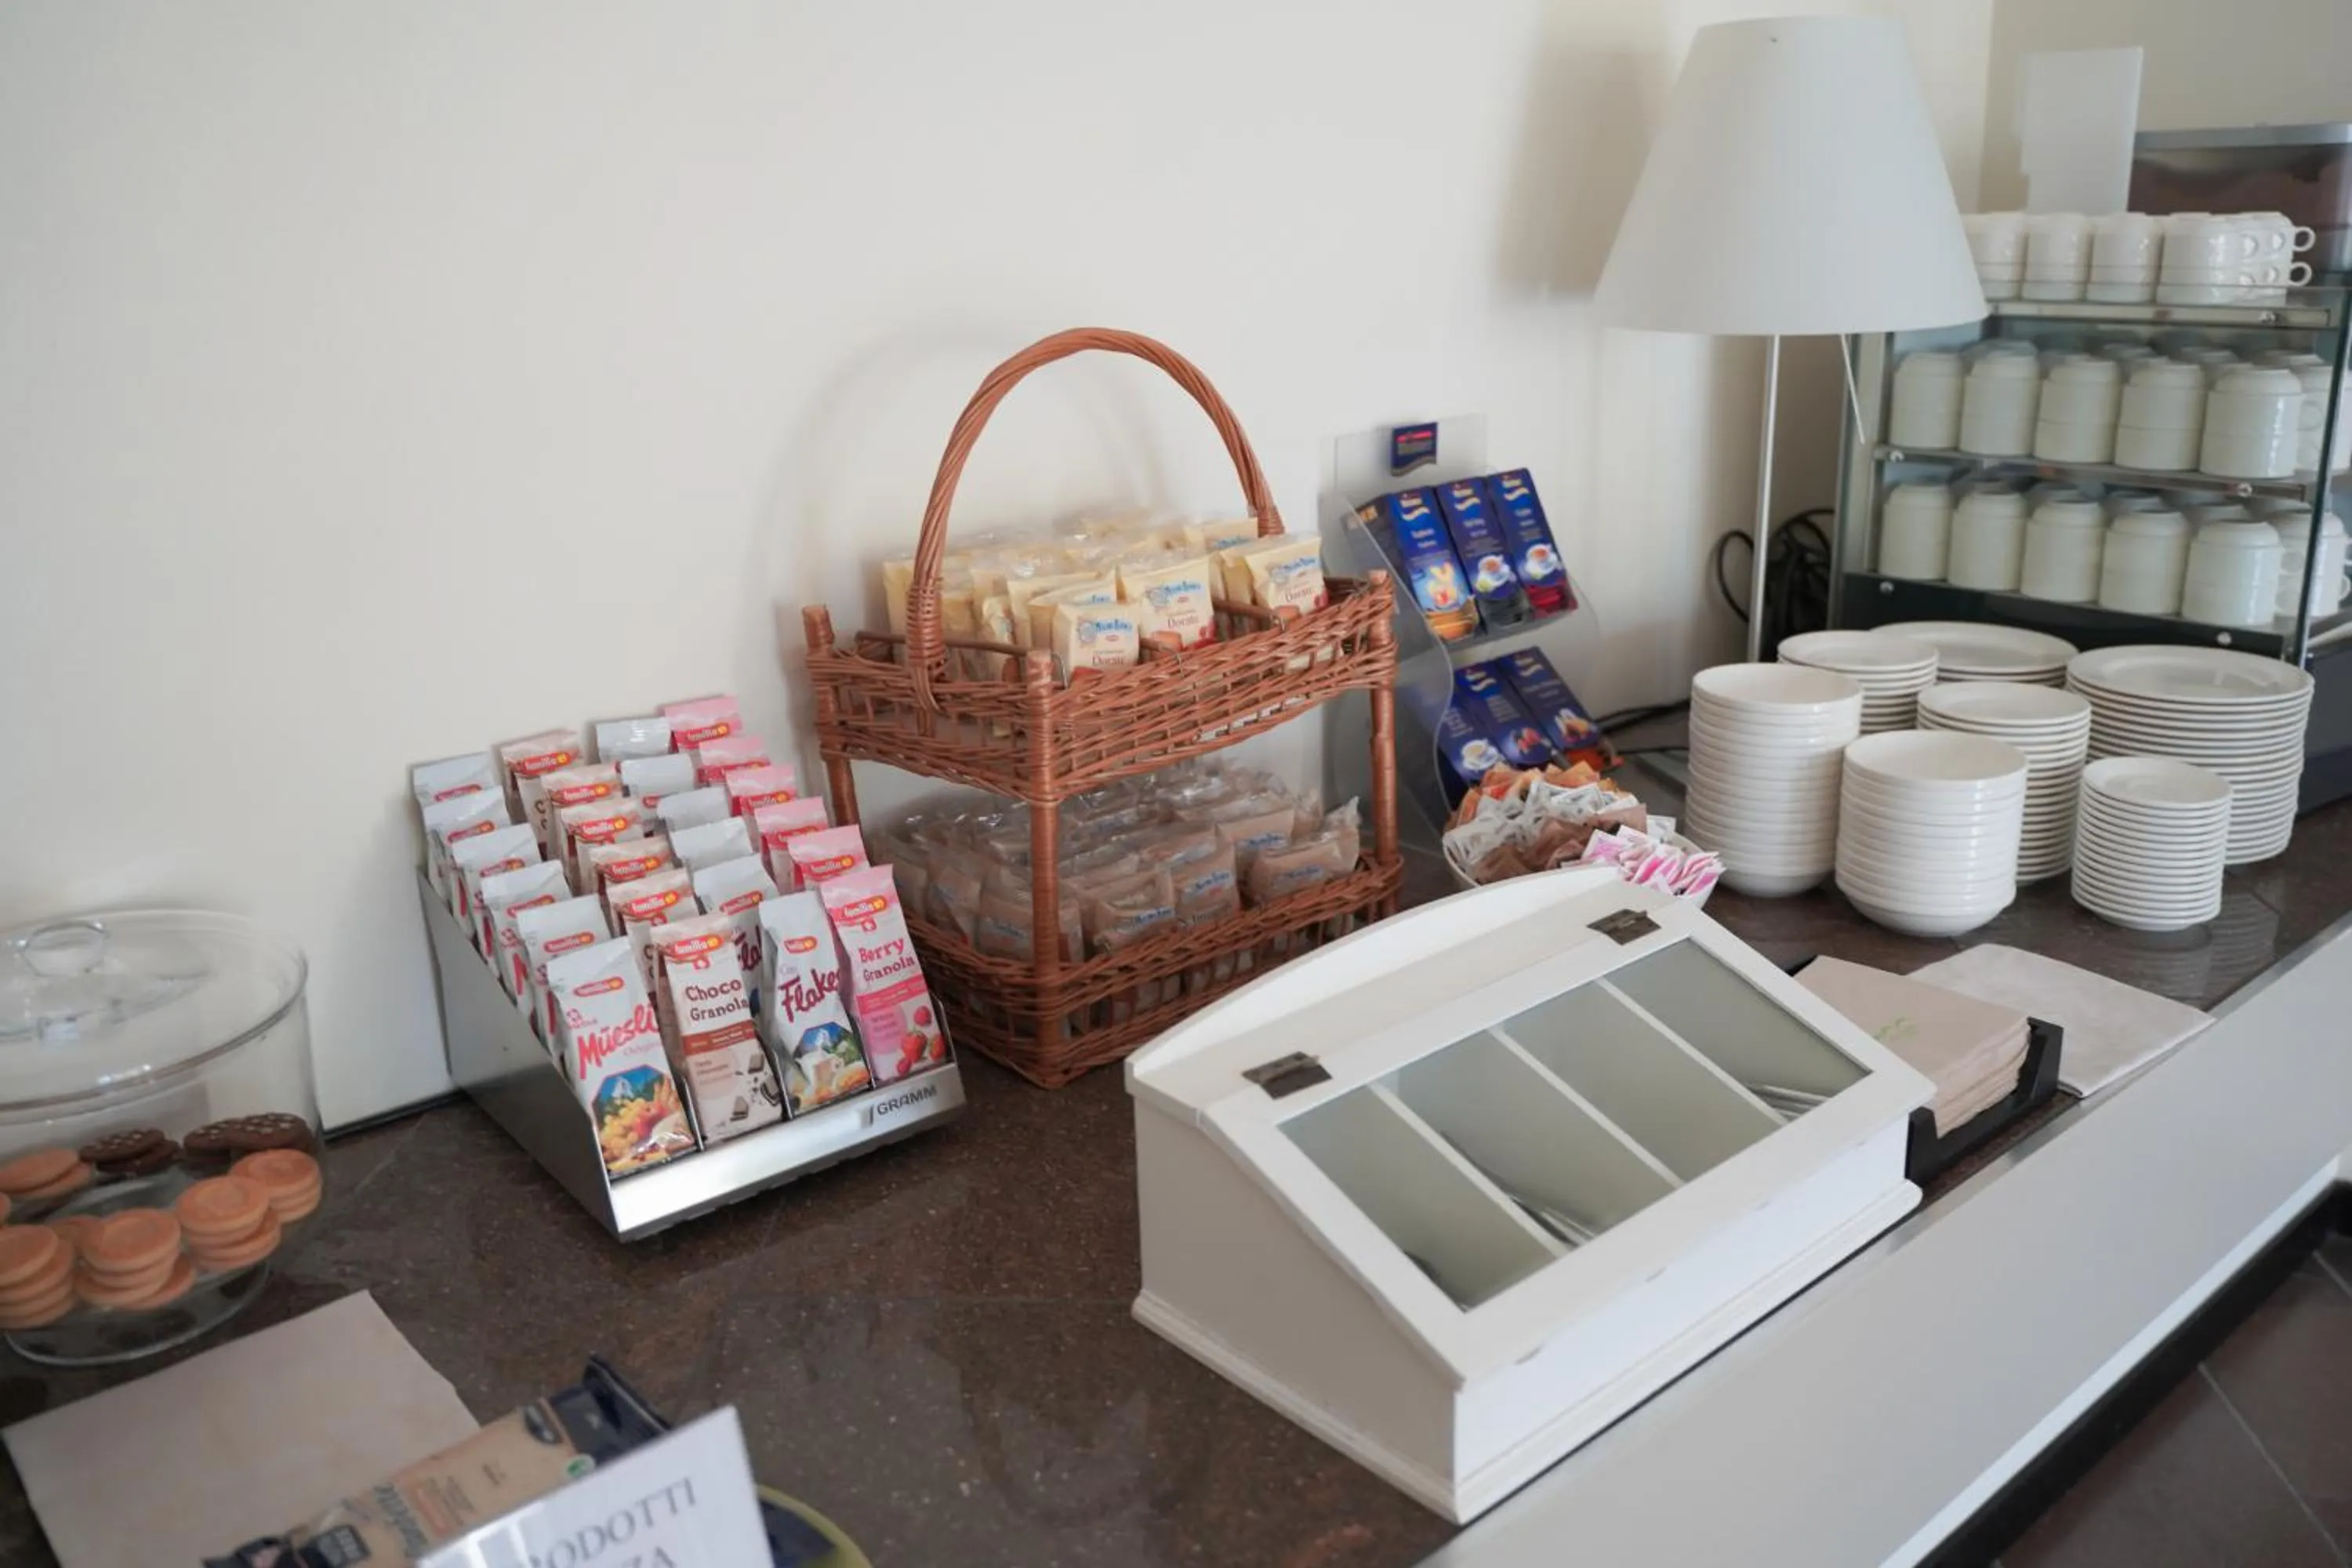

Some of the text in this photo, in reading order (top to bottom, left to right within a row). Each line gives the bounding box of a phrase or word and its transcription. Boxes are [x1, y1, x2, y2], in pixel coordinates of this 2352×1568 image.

[858, 937, 905, 964] Berry
[863, 956, 916, 982] Granola
[684, 978, 742, 1002] Choco
[689, 997, 749, 1022] Granola
[578, 1002, 659, 1080] Müesli
